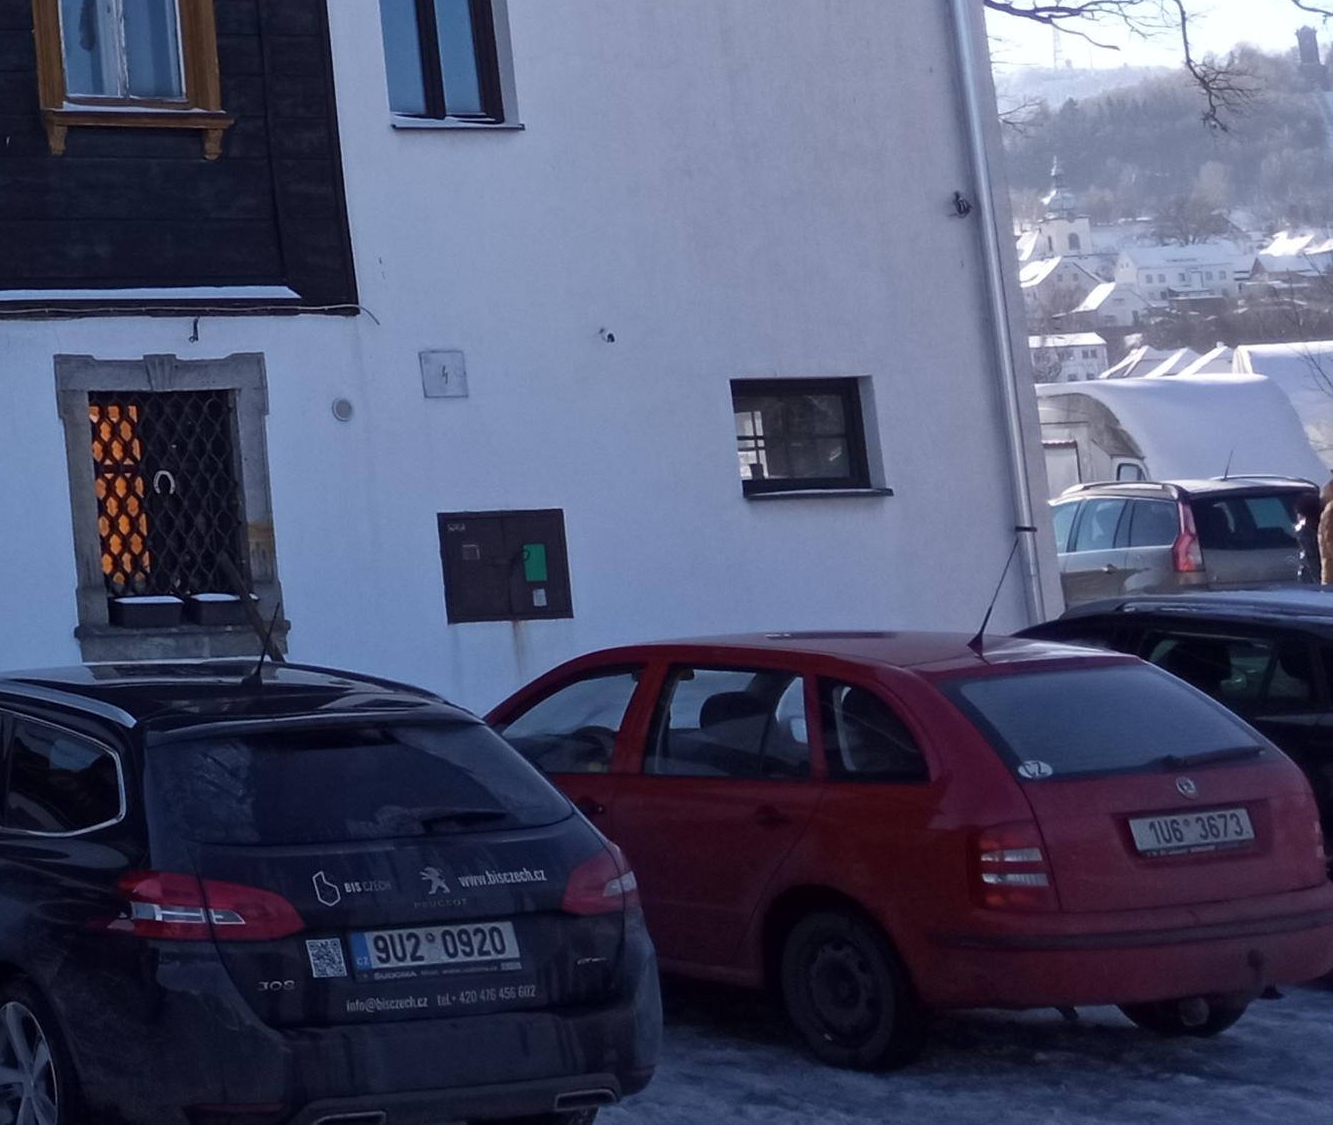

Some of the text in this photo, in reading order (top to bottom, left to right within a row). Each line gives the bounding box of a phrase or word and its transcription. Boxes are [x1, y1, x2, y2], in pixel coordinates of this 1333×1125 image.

[1148, 812, 1244, 845] 1U6 3673
[457, 867, 548, 888] www.bisczech.cz
[373, 926, 507, 964] 9U2 0920
